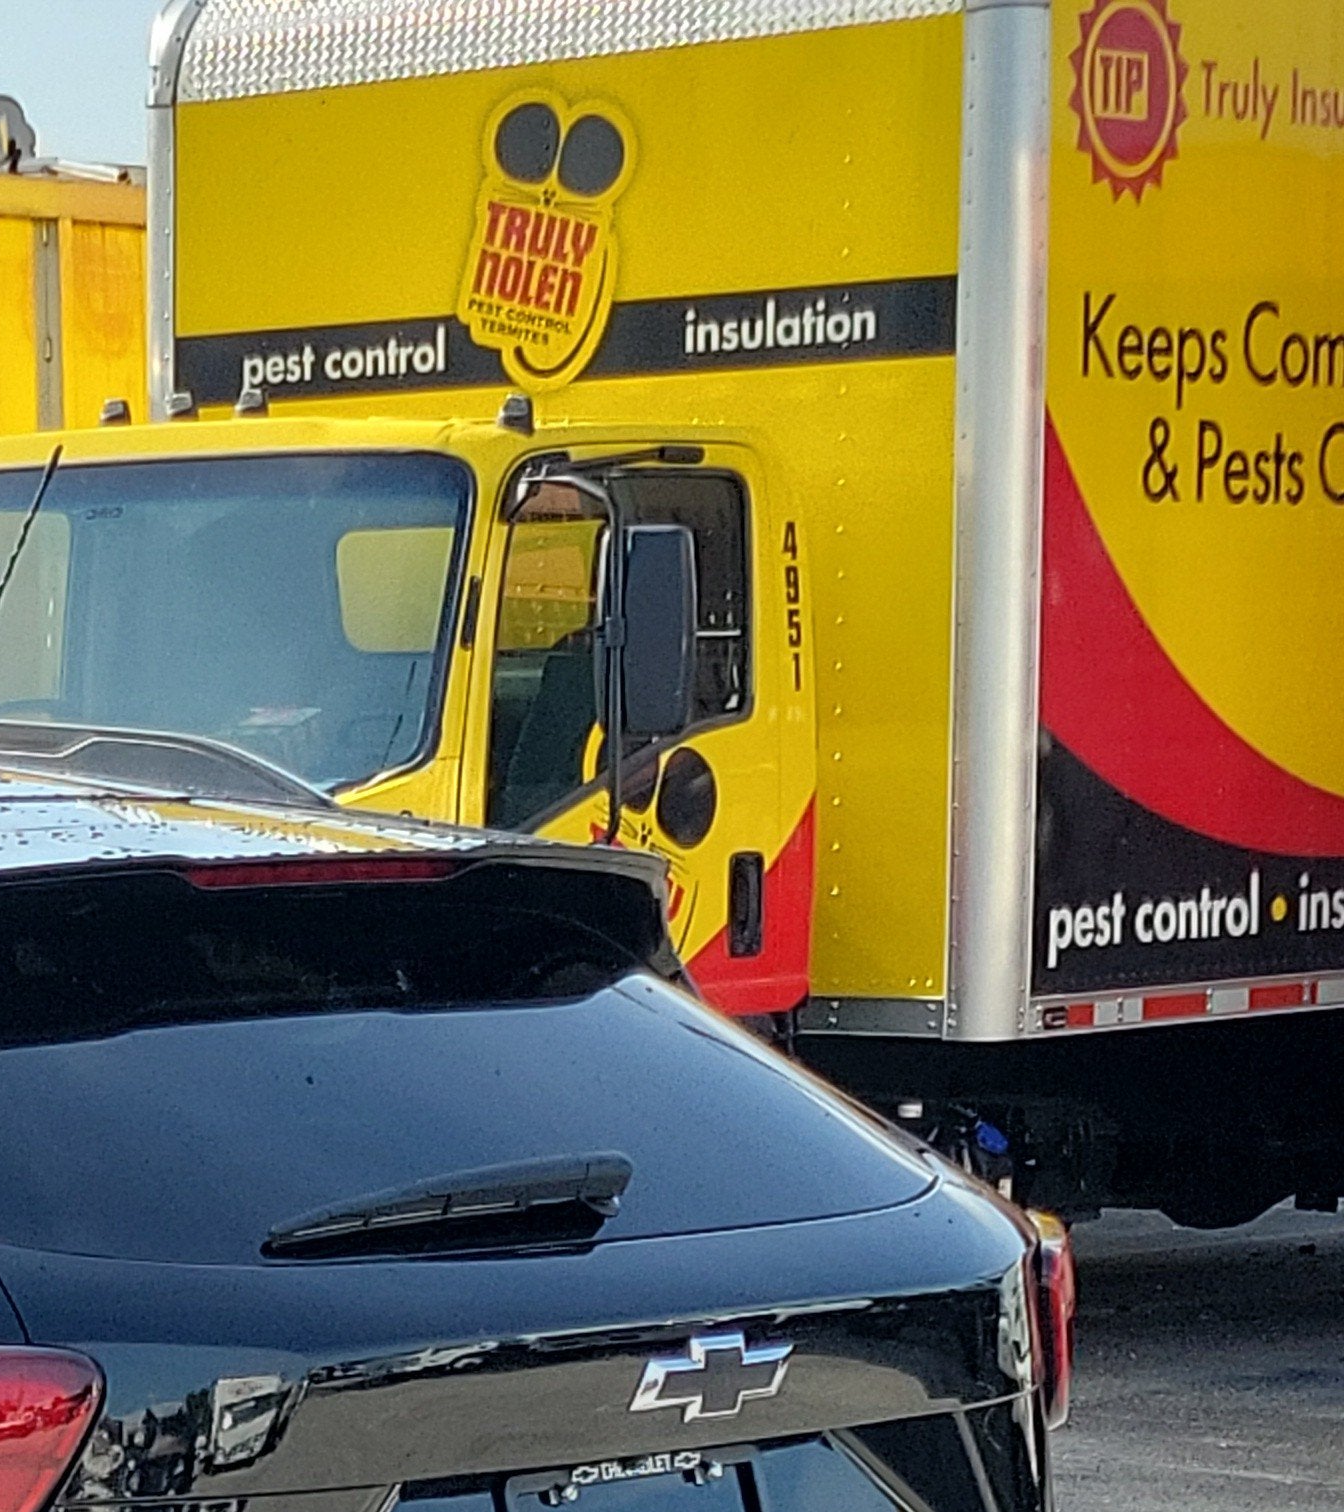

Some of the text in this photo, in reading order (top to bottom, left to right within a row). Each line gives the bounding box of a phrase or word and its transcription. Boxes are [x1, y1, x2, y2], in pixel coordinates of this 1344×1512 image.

[1099, 54, 1145, 113] TIP
[1200, 54, 1280, 140] Truly
[485, 200, 598, 267] TRULY
[241, 323, 446, 394] pest control
[684, 296, 877, 354] insulation
[1081, 290, 1229, 411] Keeps
[1142, 416, 1180, 504] &
[1196, 418, 1305, 505] Pests
[782, 520, 802, 692] 4951
[1047, 890, 1125, 969] pest
[1134, 868, 1260, 943] control
